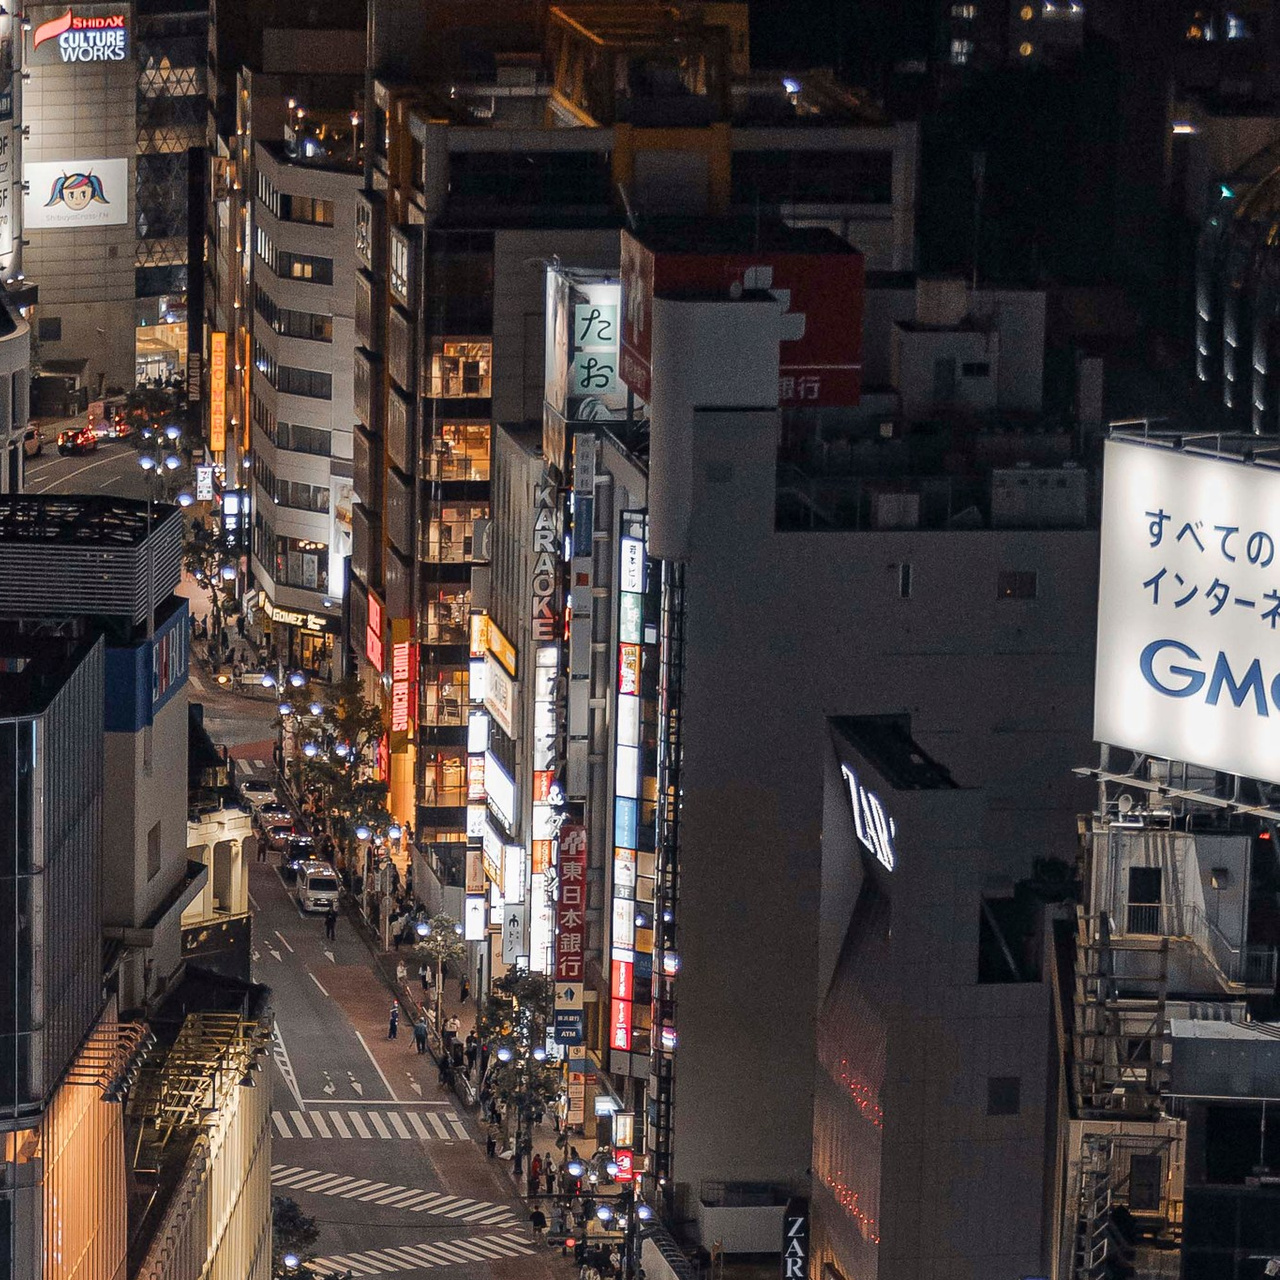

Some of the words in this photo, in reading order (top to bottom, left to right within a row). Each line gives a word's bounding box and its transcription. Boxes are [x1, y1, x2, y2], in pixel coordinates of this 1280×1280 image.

[59, 30, 125, 48] CULTURE
[72, 15, 124, 29] SHIDAX
[60, 45, 125, 62] WORKS
[1145, 508, 1275, 569] すべての
[534, 484, 556, 640] KARAOKE
[393, 641, 409, 680] TOWER
[1140, 639, 1280, 717] GM
[392, 682, 408, 732] RECORDS
[558, 860, 584, 977] 東日本銀行
[560, 1030, 576, 1038] ATM
